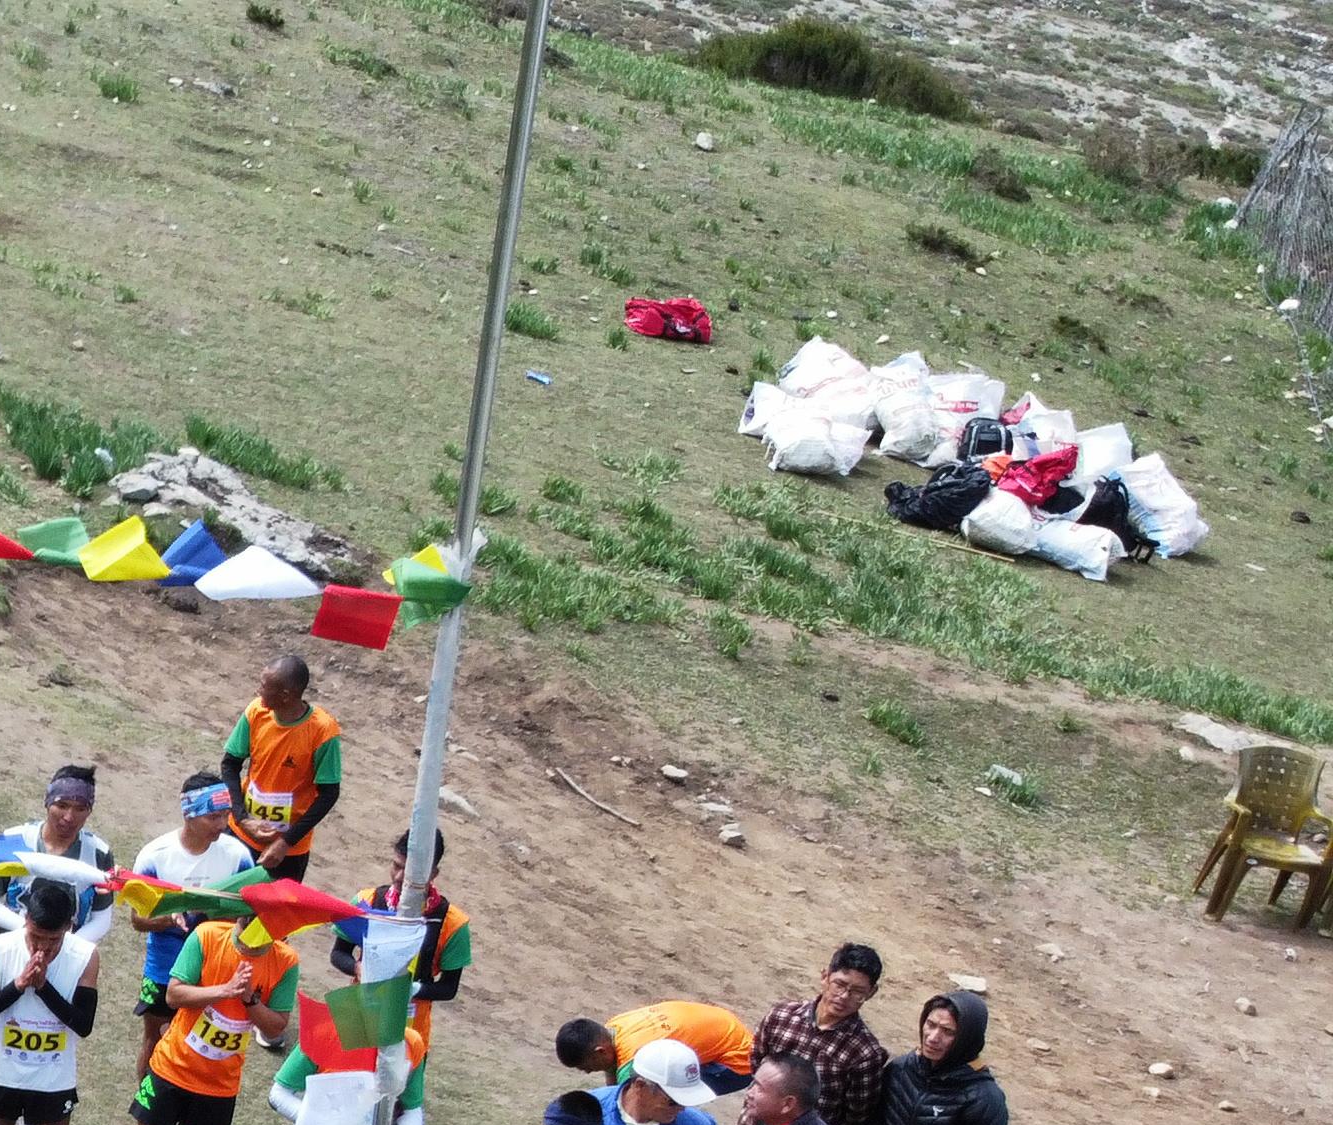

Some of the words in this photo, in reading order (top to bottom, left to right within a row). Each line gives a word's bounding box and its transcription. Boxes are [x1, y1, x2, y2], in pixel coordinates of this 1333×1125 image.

[247, 798, 285, 821] 145
[6, 1029, 60, 1052] 205
[200, 1020, 243, 1051] 183
